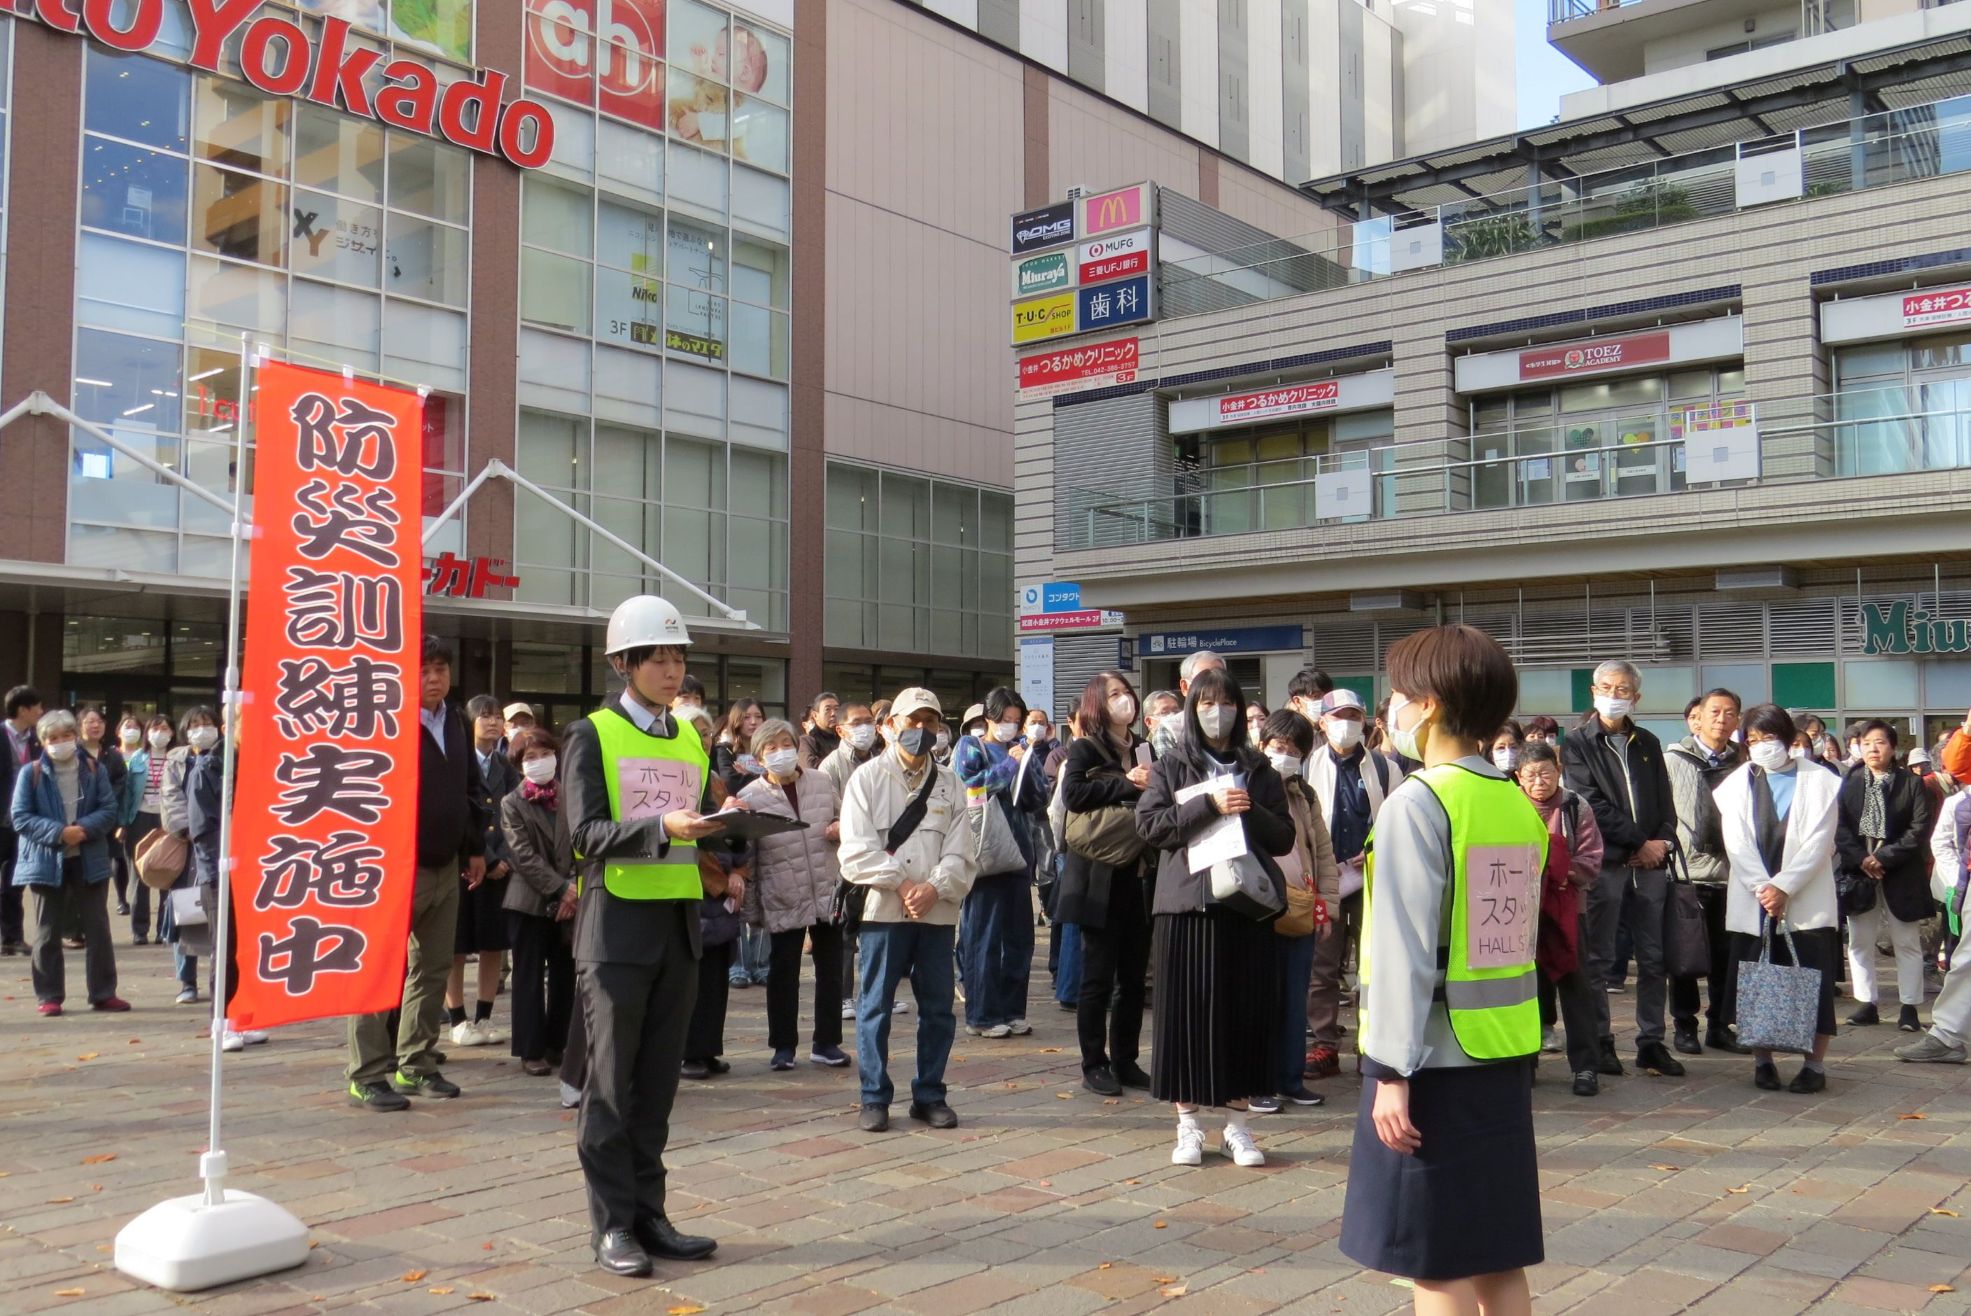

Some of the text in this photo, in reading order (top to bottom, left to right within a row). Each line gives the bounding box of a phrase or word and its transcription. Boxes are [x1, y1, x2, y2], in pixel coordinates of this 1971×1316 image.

[1106, 238, 1133, 252] MUFG
[1021, 262, 1065, 285] Miuraya
[1088, 258, 1138, 277] 三菱UFJ銀行
[1089, 285, 1139, 320] 歯科
[1051, 309, 1072, 321] SHOP
[610, 320, 627, 336] 3F
[1040, 342, 1135, 373] つるかめクリニック
[1584, 344, 1622, 360] TOEZ
[1584, 355, 1622, 367] ACADEMY
[1246, 384, 1336, 408] つるかめクリニック
[1167, 635, 1197, 649] 駐輪場
[254, 391, 403, 996] 防災訓練実施中
[640, 766, 693, 788] ホール
[1489, 858, 1523, 888] ホー
[1481, 895, 1527, 927] スタッ
[1479, 936, 1516, 955] HALL
